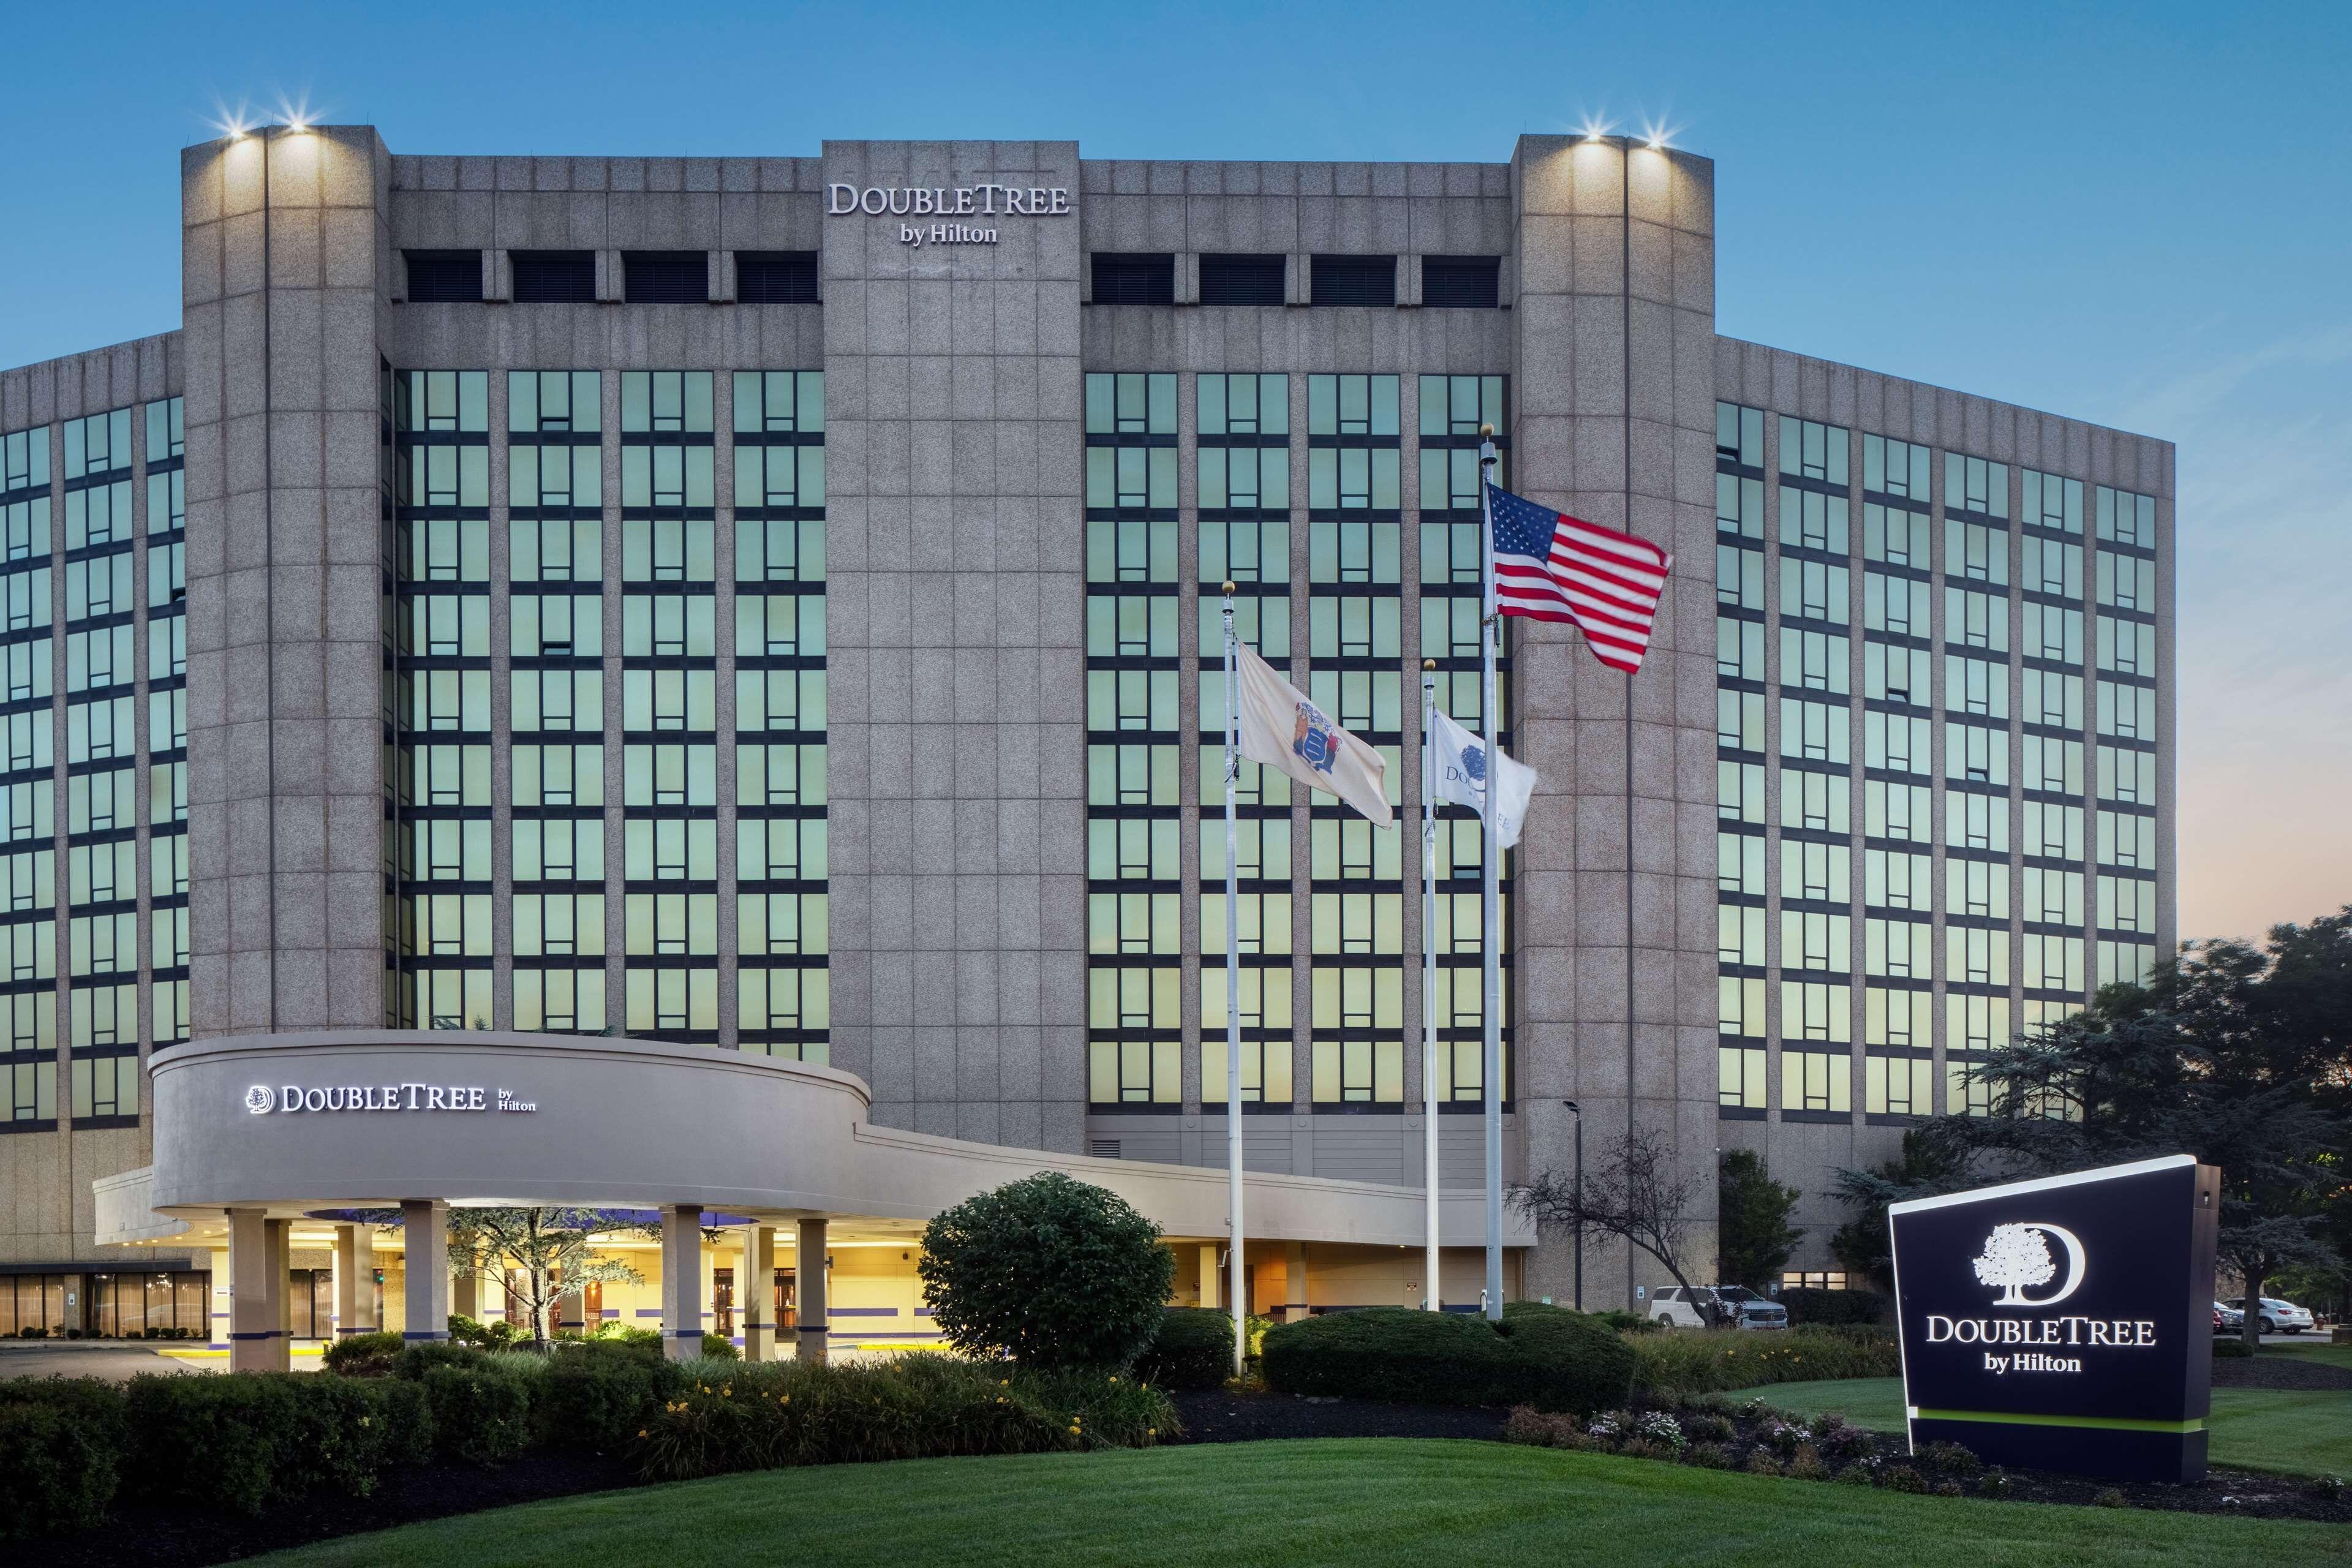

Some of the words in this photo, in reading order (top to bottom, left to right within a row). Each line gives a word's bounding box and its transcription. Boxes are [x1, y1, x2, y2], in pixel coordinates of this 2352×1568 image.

[829, 184, 1069, 214] DOUBLETREE
[900, 223, 926, 247] by
[930, 224, 997, 243] Hilton
[281, 1083, 486, 1112] DOUBLETREE
[499, 1088, 513, 1101] by
[499, 1100, 536, 1111] Hilton
[1926, 1315, 2157, 1346] DOUBLETREE
[1984, 1352, 2010, 1374] by
[2013, 1353, 2082, 1372] Hilton
